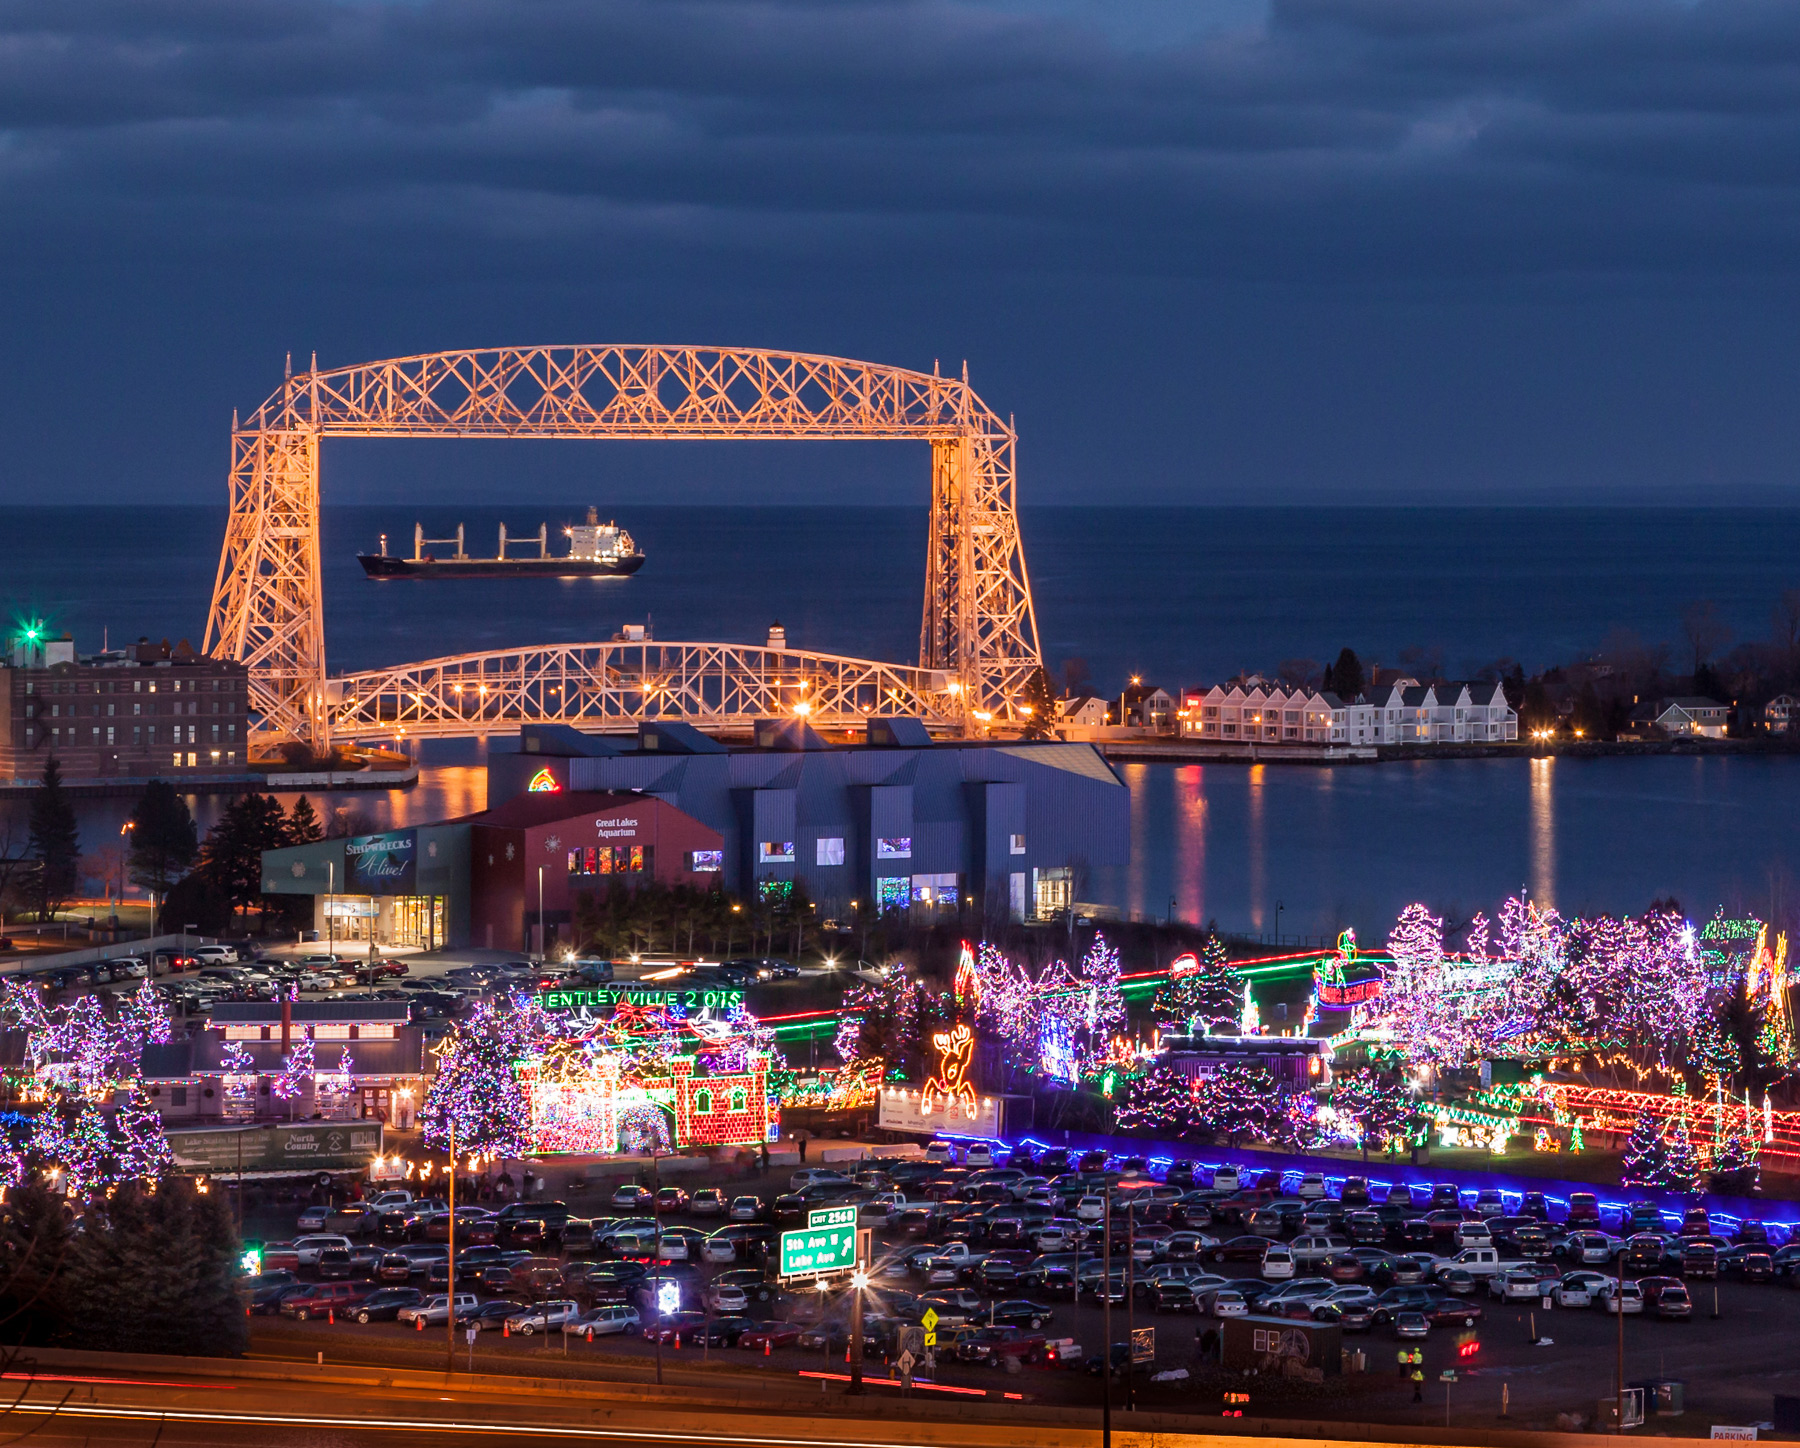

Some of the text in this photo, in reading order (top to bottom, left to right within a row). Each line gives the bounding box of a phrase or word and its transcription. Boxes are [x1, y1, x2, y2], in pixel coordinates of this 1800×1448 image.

[595, 818, 638, 827] Great Lakes
[598, 829, 636, 839] Aquarium
[346, 839, 412, 856] SHIPWRECKS
[354, 854, 409, 877] Alive!
[289, 1133, 315, 1143] North
[284, 1142, 320, 1152] Country
[378, 1166, 399, 1175] EXIT
[812, 1215, 827, 1225] EXIT
[786, 1233, 839, 1252] 5th Ave W
[788, 1252, 836, 1269] Lake Ave
[1714, 1432, 1753, 1441] PARKING
